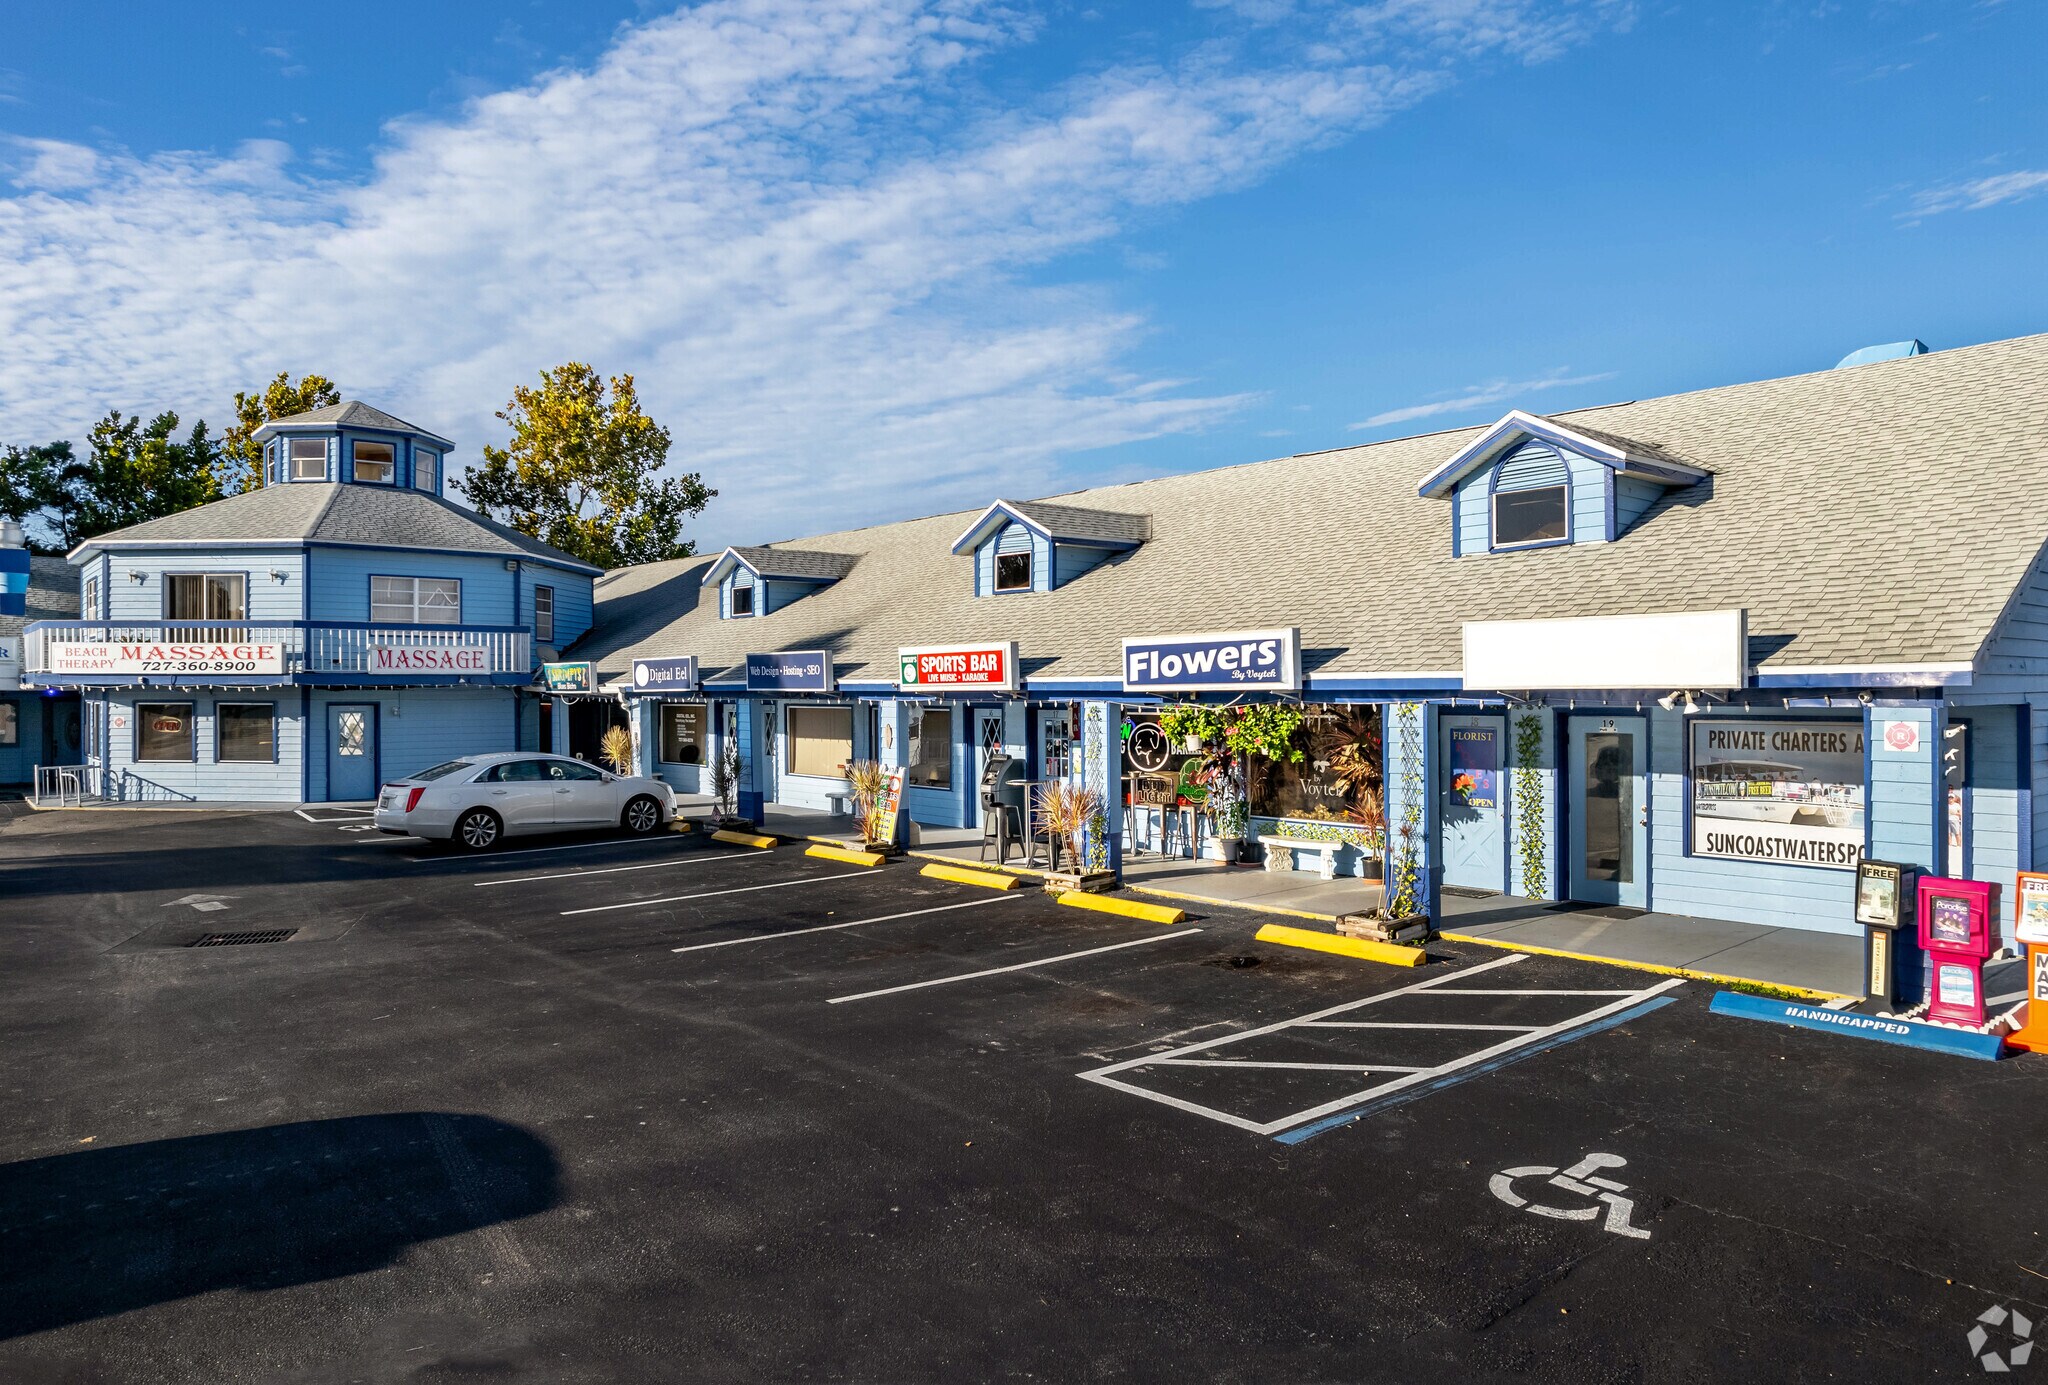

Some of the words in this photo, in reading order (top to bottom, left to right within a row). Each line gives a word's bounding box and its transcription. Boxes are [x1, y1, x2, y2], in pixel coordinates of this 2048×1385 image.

[65, 647, 107, 657] BEACH
[120, 645, 275, 660] MASSAGE
[57, 658, 116, 669] THERAPY
[377, 649, 485, 669] MASSAGE
[921, 655, 967, 673] SPORTS
[970, 654, 998, 671] BAR
[1129, 640, 1276, 682] Flowers
[142, 661, 256, 671] 727-360-8900
[750, 666, 760, 676] Web
[761, 665, 780, 677] Design
[783, 665, 803, 677] Hosting
[807, 664, 820, 675] SEO
[649, 666, 673, 683] Digital
[675, 666, 687, 680] Eel
[927, 674, 939, 683] LIVE
[940, 673, 958, 682] MUSIC
[962, 672, 988, 682] KARAOKE
[1231, 670, 1245, 681] By
[1246, 669, 1276, 681] Voytek
[1602, 719, 1615, 728] 19
[1453, 731, 1494, 741] FLORIST
[1709, 730, 1765, 750] PRIVATE
[1771, 731, 1847, 753] CHARTERS
[1897, 732, 1905, 740] R
[1313, 773, 1322, 784] by
[1138, 790, 1171, 803] LIGHT
[1468, 798, 1494, 808] OPEN
[1866, 868, 1894, 878] FREE
[1936, 900, 1968, 912] Paradise
[1785, 1006, 1910, 1035] HANDICAPPED
